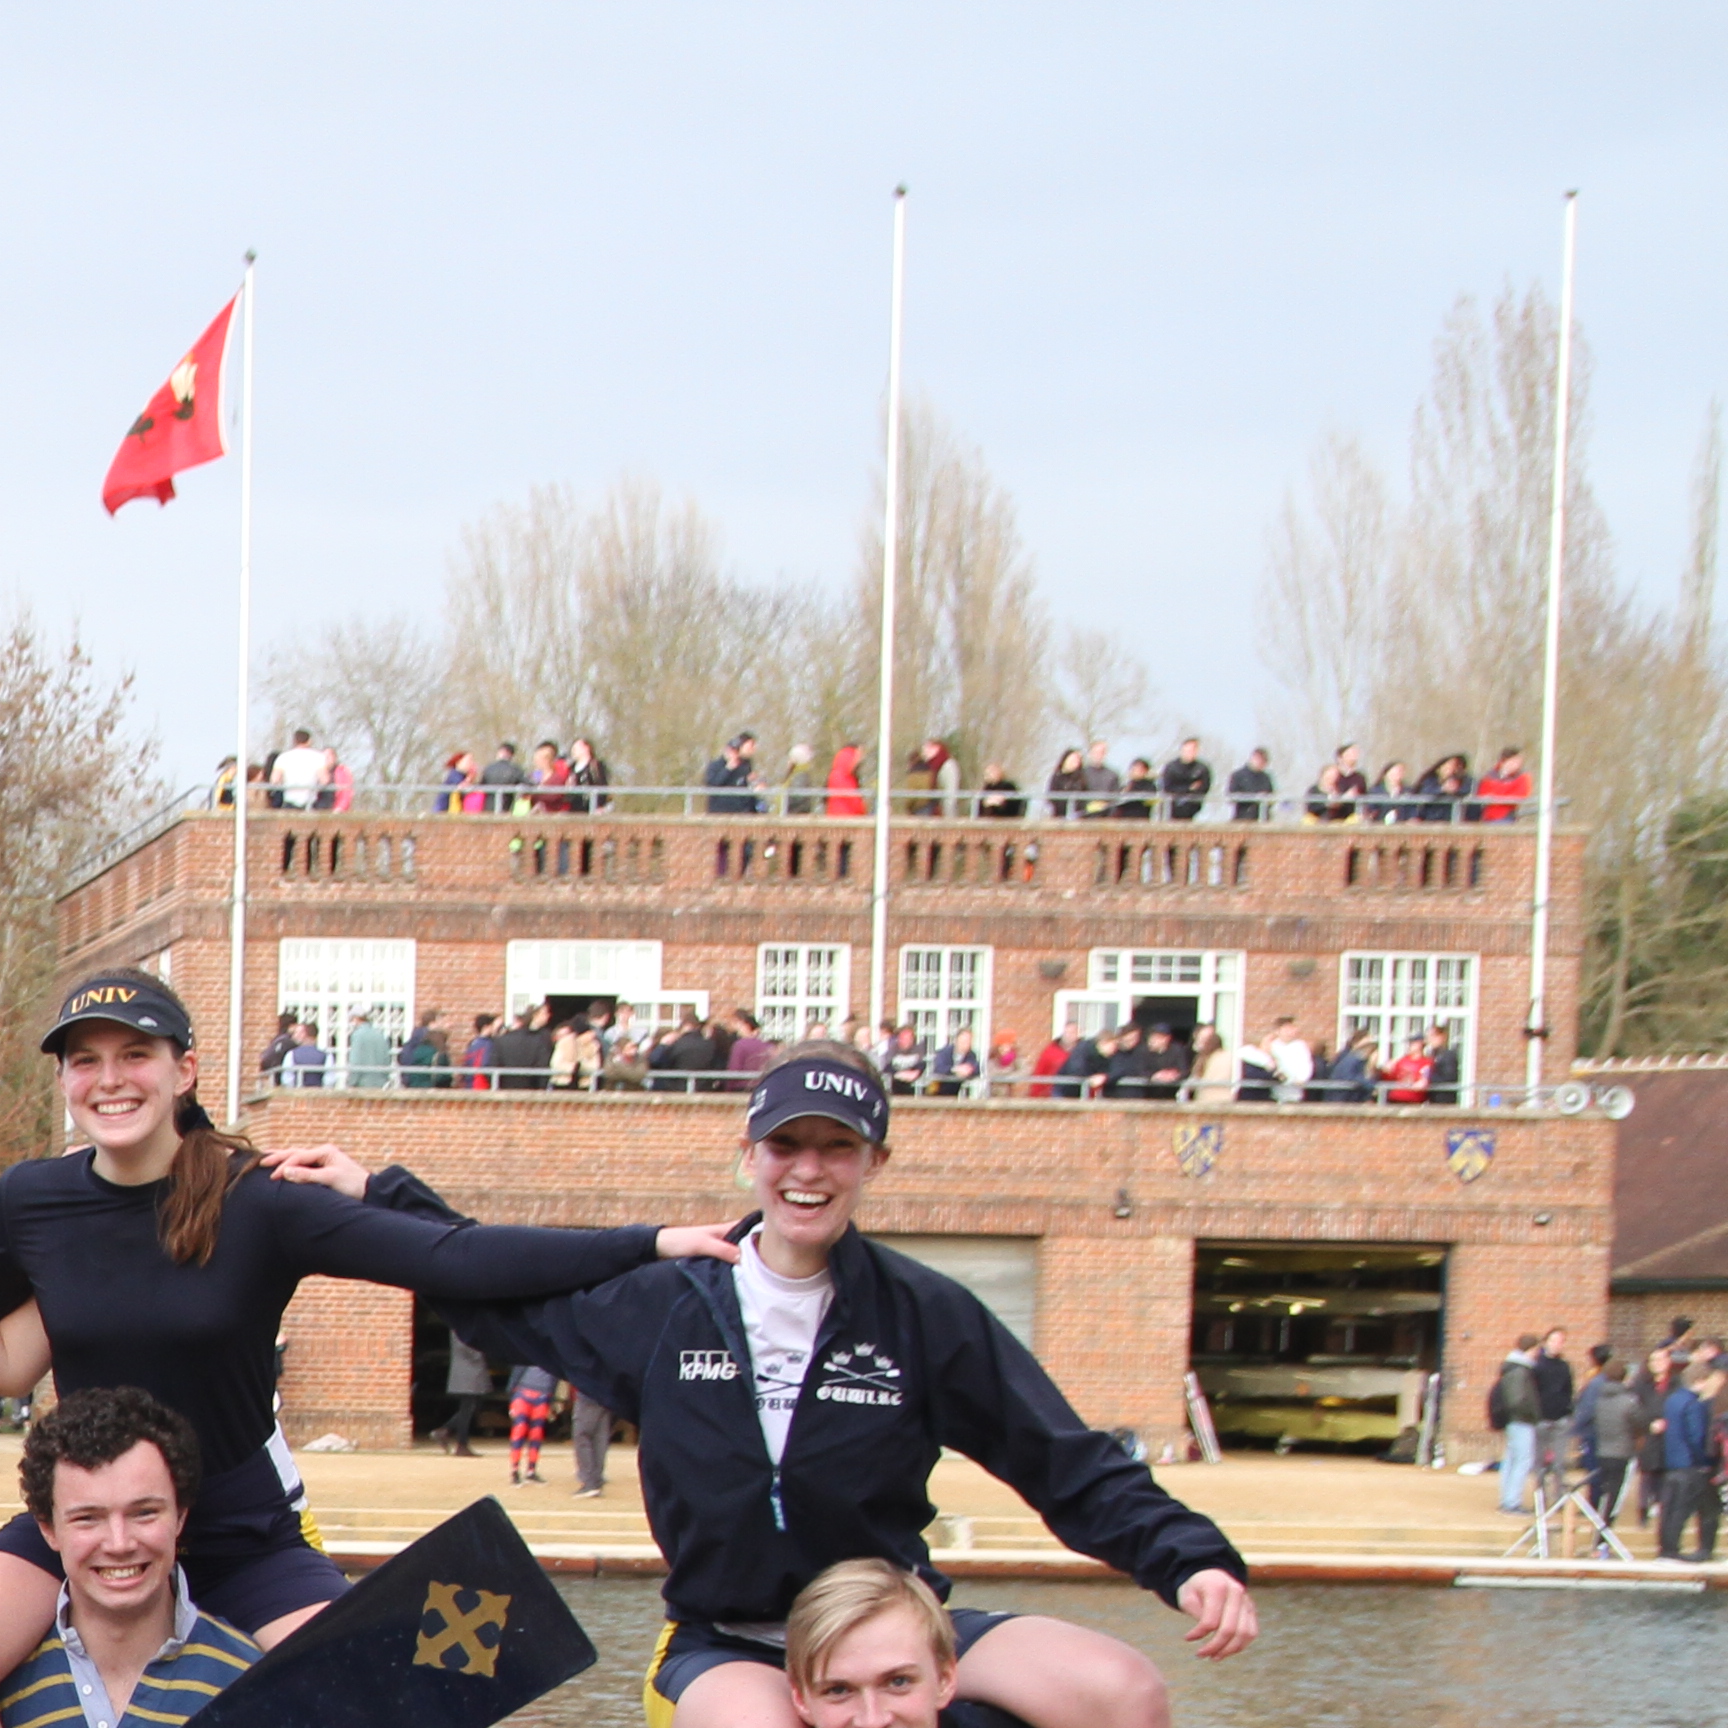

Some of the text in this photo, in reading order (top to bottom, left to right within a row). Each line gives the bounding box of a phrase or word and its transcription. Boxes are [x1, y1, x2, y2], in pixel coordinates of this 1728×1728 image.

[70, 986, 138, 1014] UNIV
[804, 1070, 867, 1101] UNIV
[678, 1361, 738, 1381] KPMG
